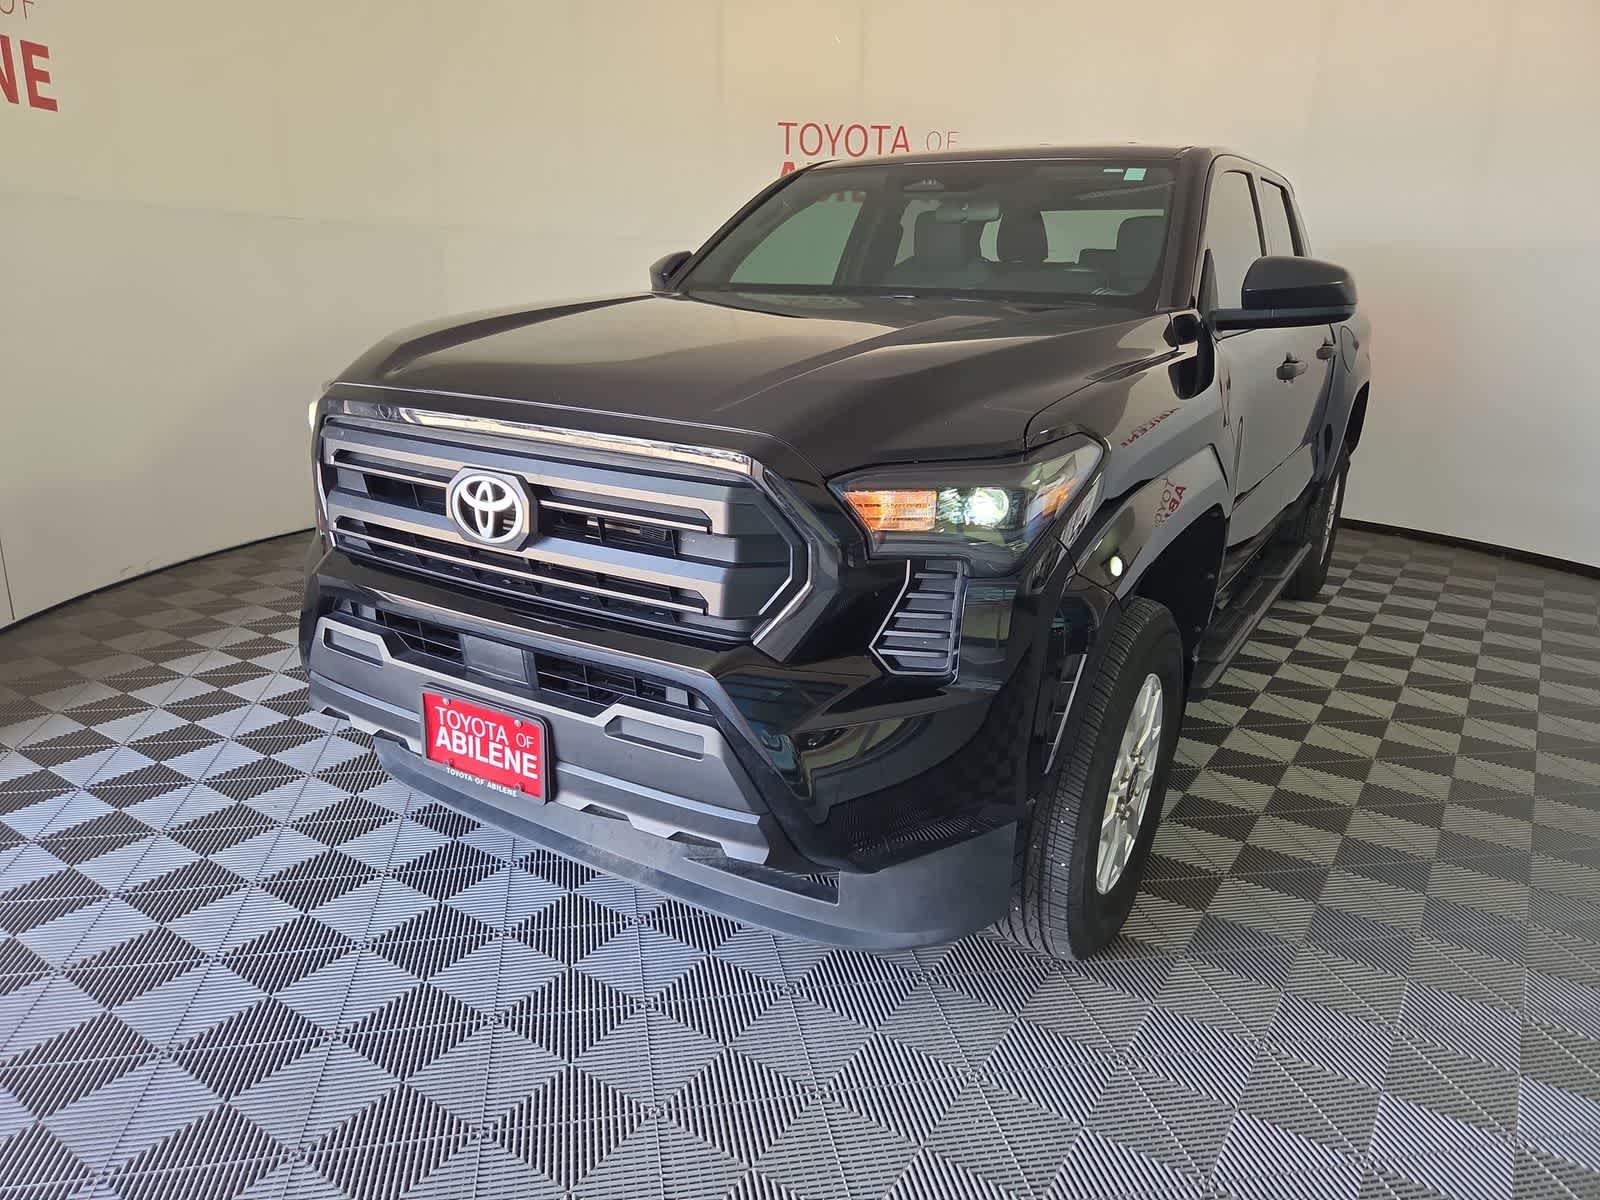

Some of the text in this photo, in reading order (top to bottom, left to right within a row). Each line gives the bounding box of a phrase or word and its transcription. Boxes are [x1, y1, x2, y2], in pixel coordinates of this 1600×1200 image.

[777, 122, 960, 157] TOYOTA OF
[434, 706, 534, 748] TOYOTA OF
[435, 726, 538, 779] ABILENE
[446, 767, 518, 797] TOYOTA OF ABILENE
